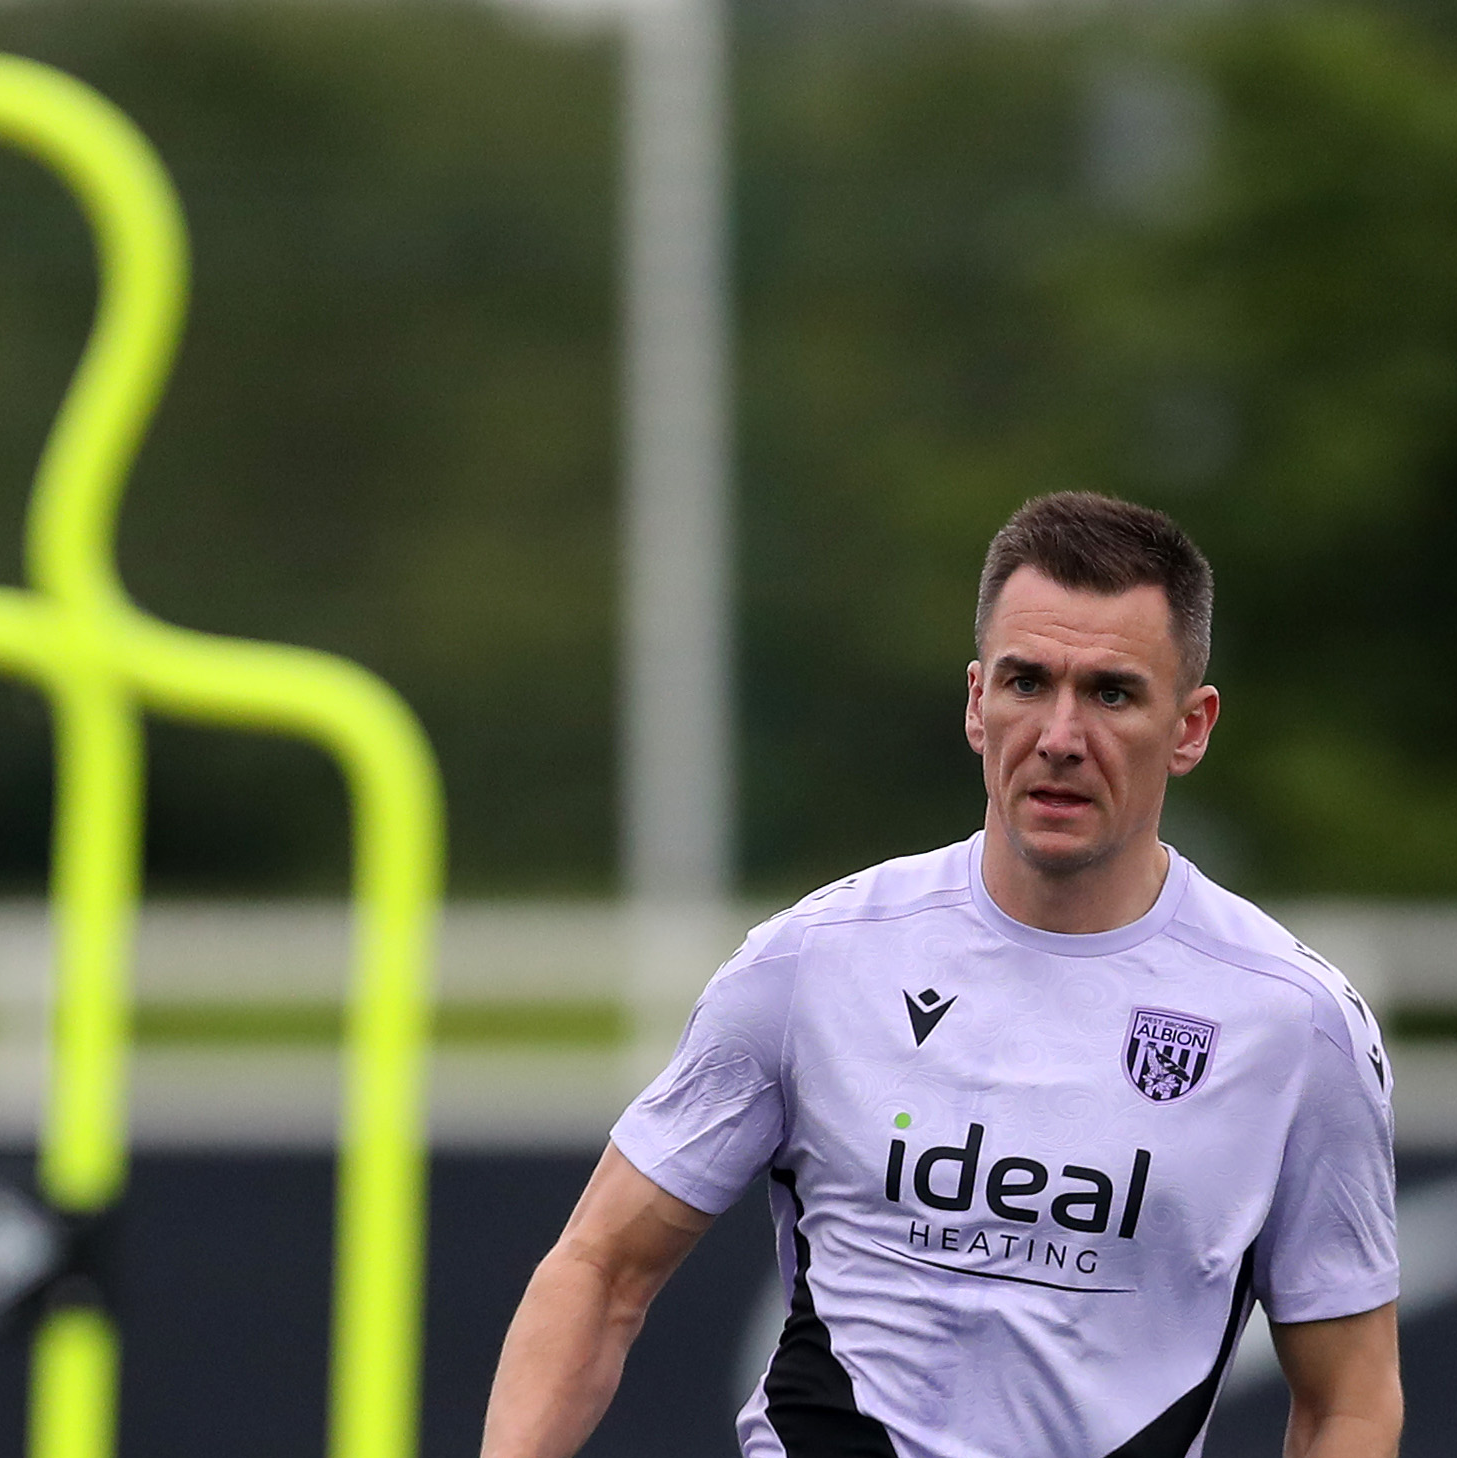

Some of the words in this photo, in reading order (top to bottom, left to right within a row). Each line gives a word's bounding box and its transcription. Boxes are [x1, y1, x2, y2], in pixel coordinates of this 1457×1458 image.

[1136, 1023, 1207, 1049] ALBION
[885, 1112, 1151, 1239] ideal
[909, 1221, 1099, 1274] HEATING
